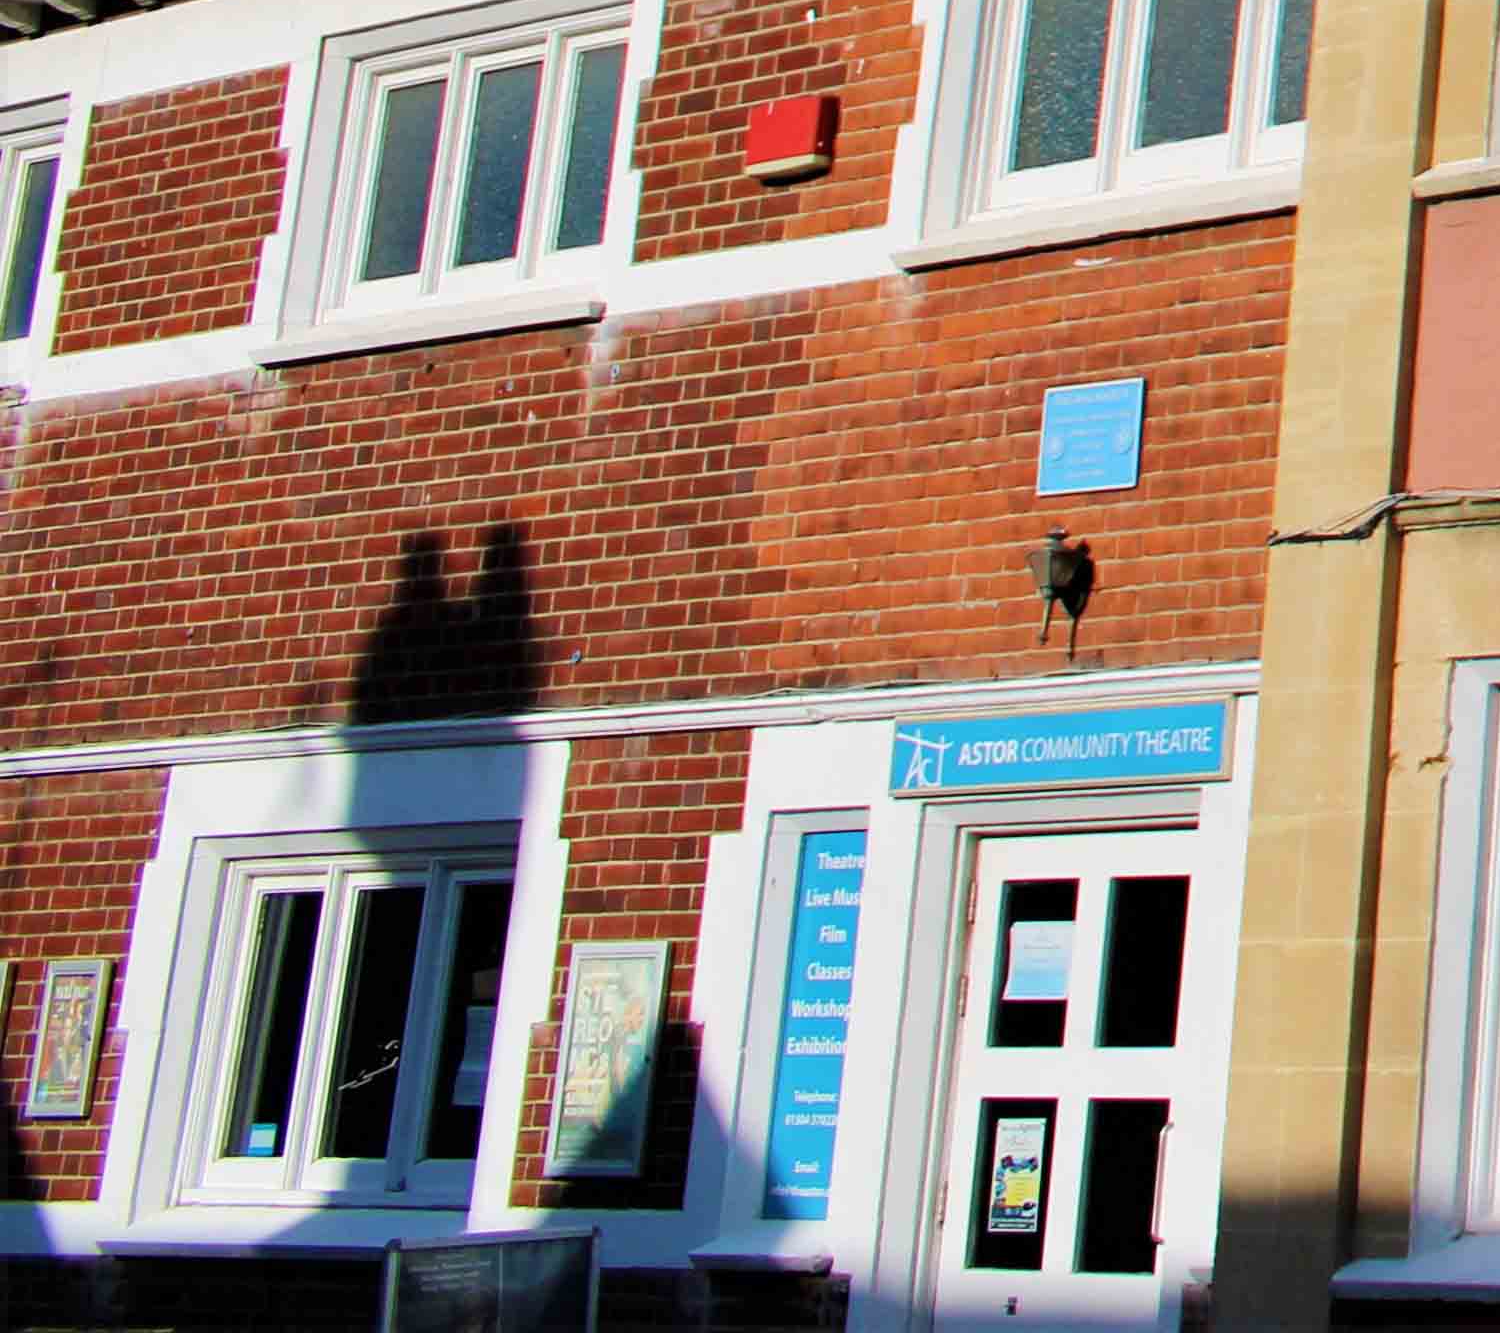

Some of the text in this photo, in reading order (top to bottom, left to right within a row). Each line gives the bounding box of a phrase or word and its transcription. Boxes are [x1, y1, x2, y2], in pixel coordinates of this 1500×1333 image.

[958, 741, 1018, 766] ASTOR
[1021, 732, 1132, 763] COMMUNITY
[1135, 726, 1214, 755] THEATRE
[805, 888, 831, 907] Live
[820, 925, 847, 944] Film
[807, 962, 853, 981] Classes
